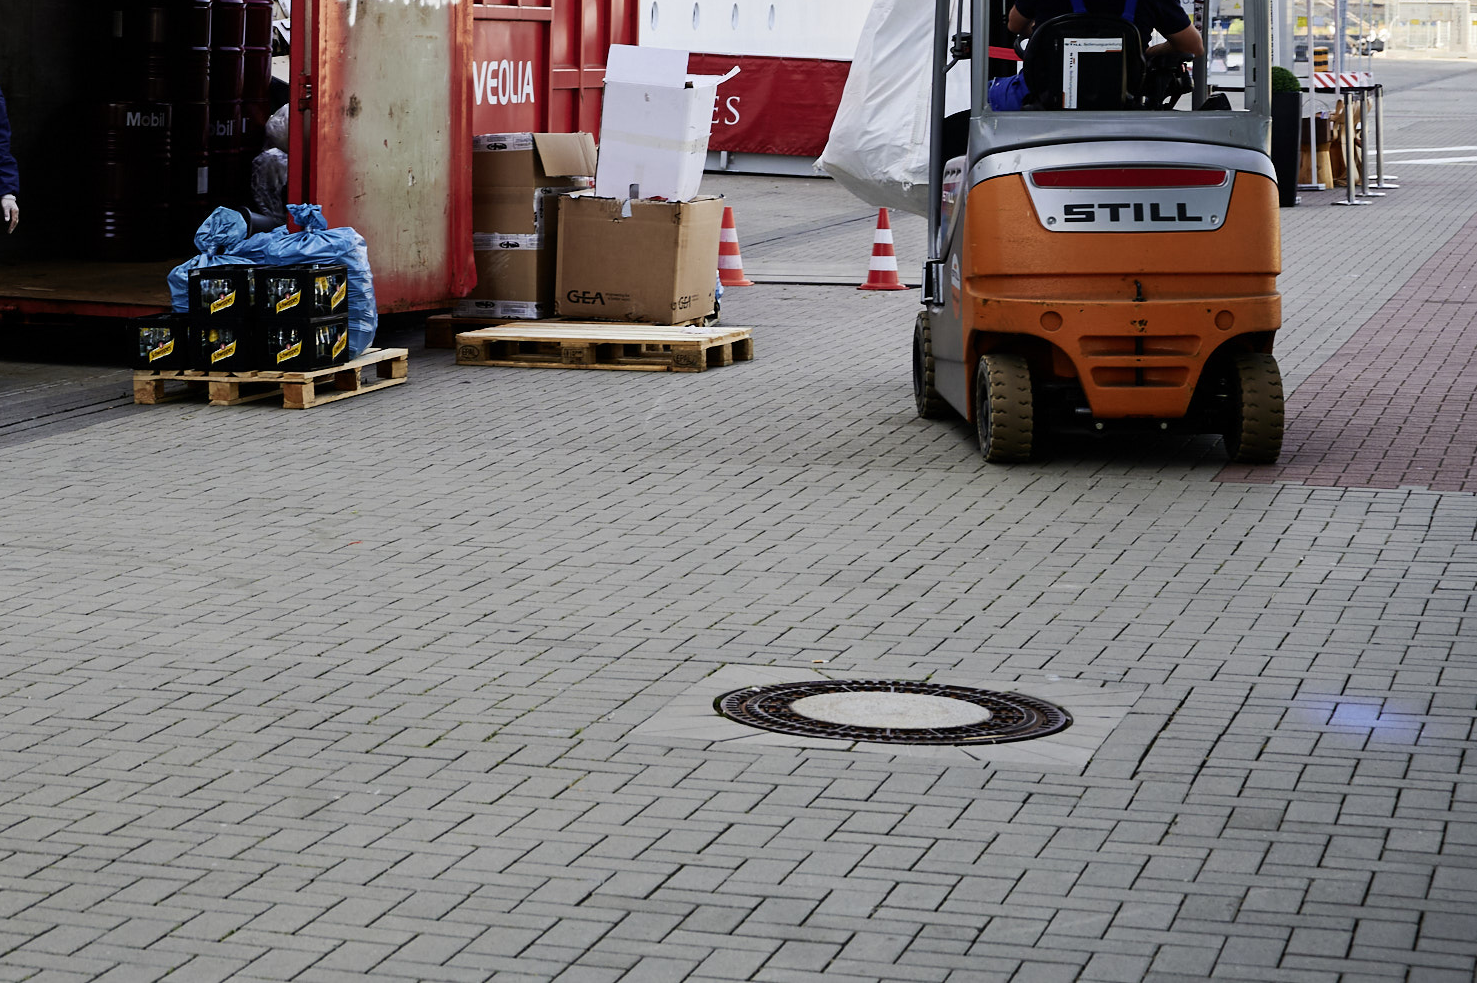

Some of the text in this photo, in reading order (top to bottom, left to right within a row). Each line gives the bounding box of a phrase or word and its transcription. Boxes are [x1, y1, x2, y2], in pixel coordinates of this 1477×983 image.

[473, 60, 535, 105] VEOLIA
[126, 111, 165, 127] Mobil
[1064, 202, 1202, 222] STILL
[567, 289, 605, 305] GEA
